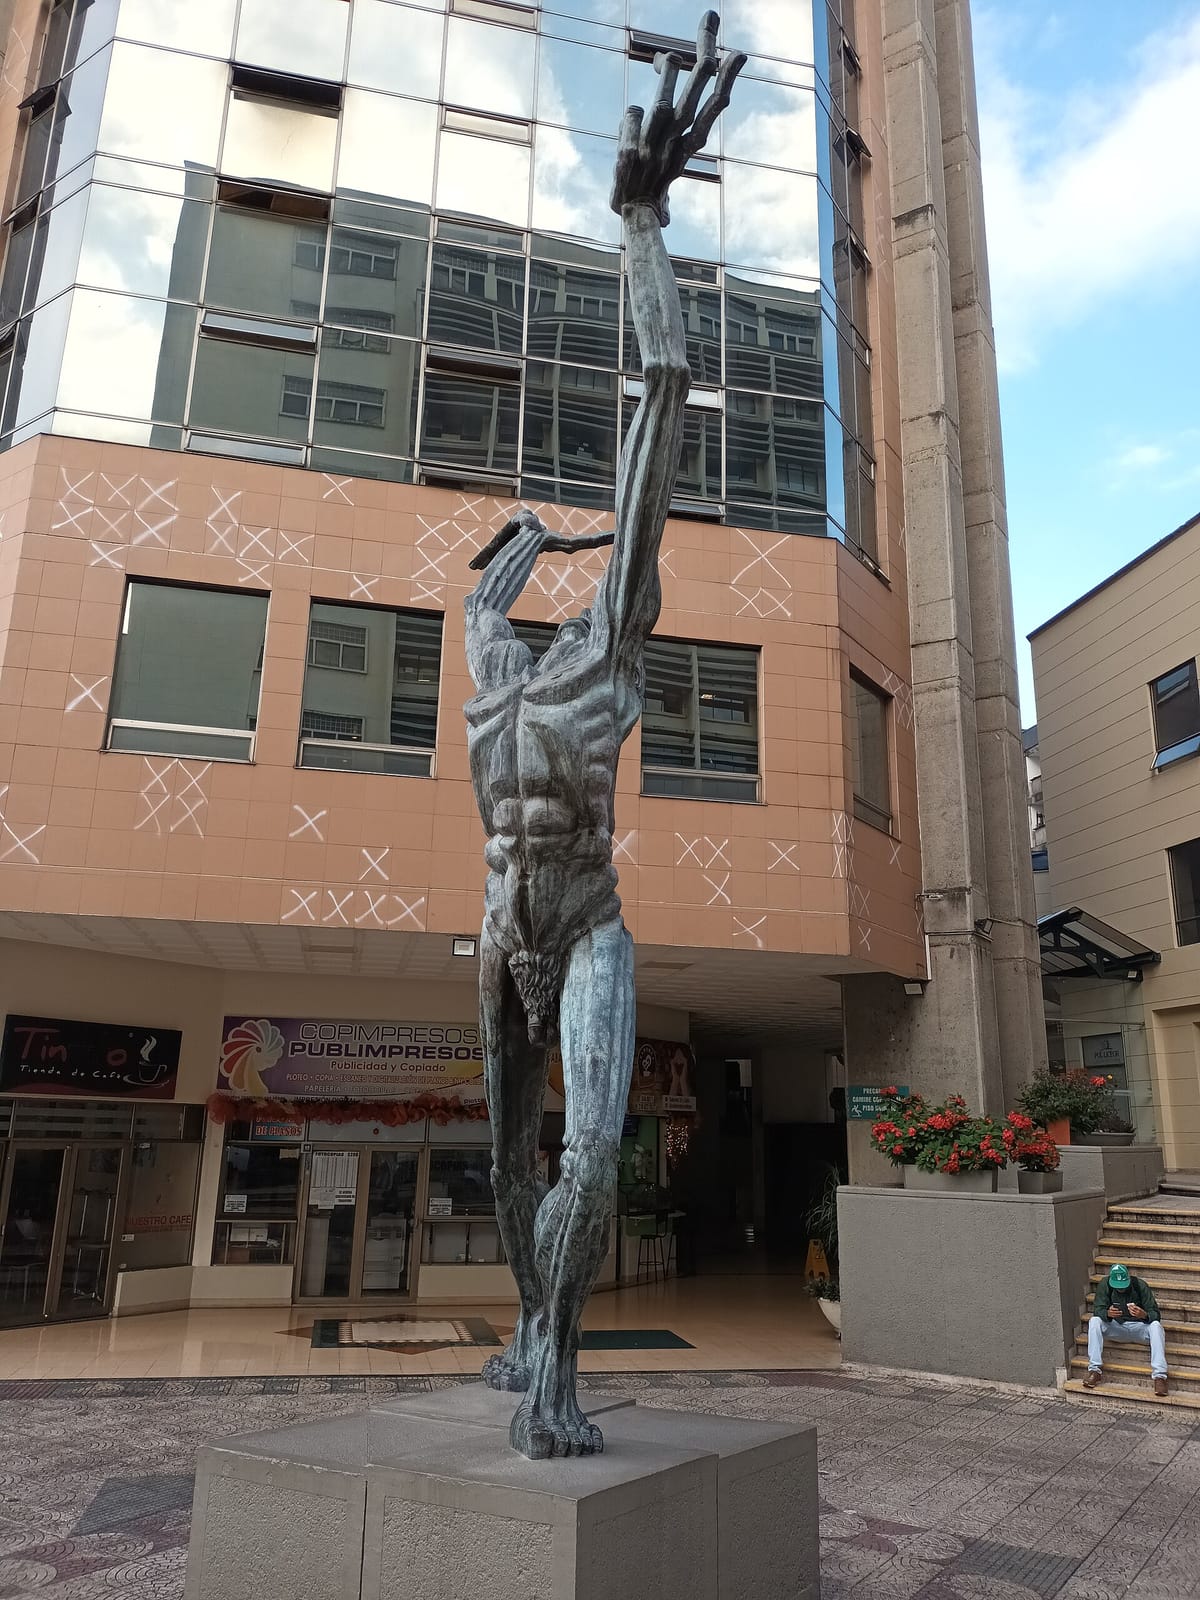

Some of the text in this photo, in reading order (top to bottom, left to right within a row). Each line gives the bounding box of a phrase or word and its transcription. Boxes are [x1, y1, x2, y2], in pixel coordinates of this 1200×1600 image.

[301, 1024, 478, 1044] COPIMPRESOS
[290, 1041, 483, 1060] PUBLIMPRESOS
[331, 1061, 387, 1071] Publicidad
[400, 1062, 446, 1073] Copiado
